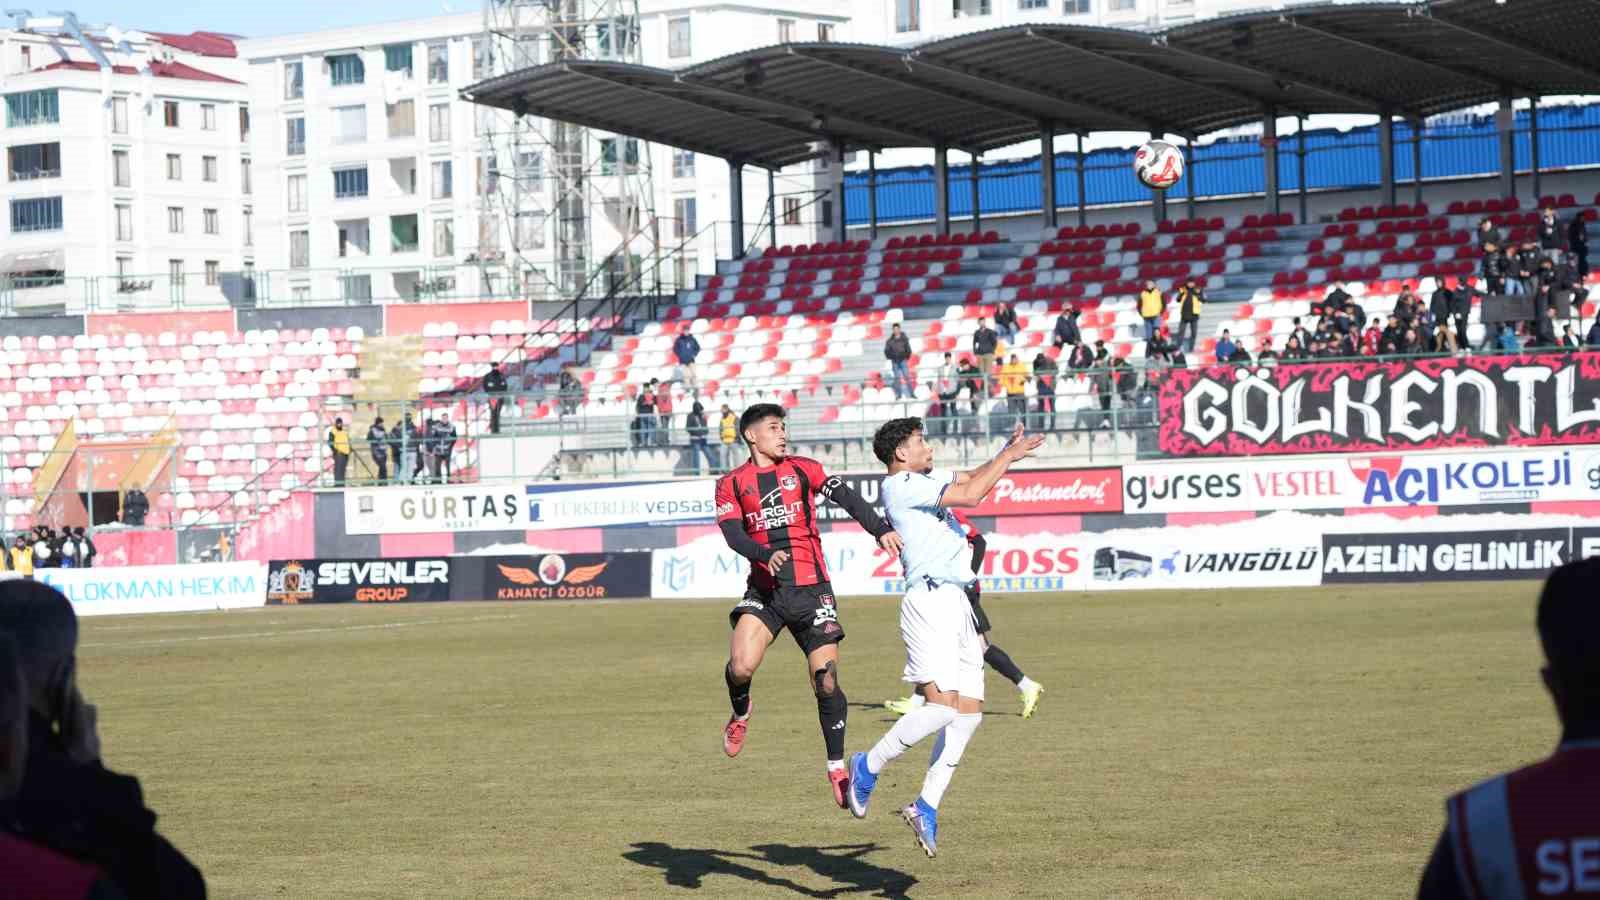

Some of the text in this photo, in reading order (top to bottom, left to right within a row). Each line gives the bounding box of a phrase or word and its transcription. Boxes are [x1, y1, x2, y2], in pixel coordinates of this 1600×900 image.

[1254, 470, 1342, 497] VESTEL
[1363, 468, 1439, 505] AÇI
[400, 490, 518, 524] GÜRTAŞ
[746, 501, 803, 524] TURGUT
[756, 513, 797, 531] FIRAT
[1184, 546, 1318, 573] VANGÖLÜ
[317, 560, 449, 585] SEVENLER
[69, 580, 173, 601] LOKMAN
[356, 587, 407, 601] GROUP
